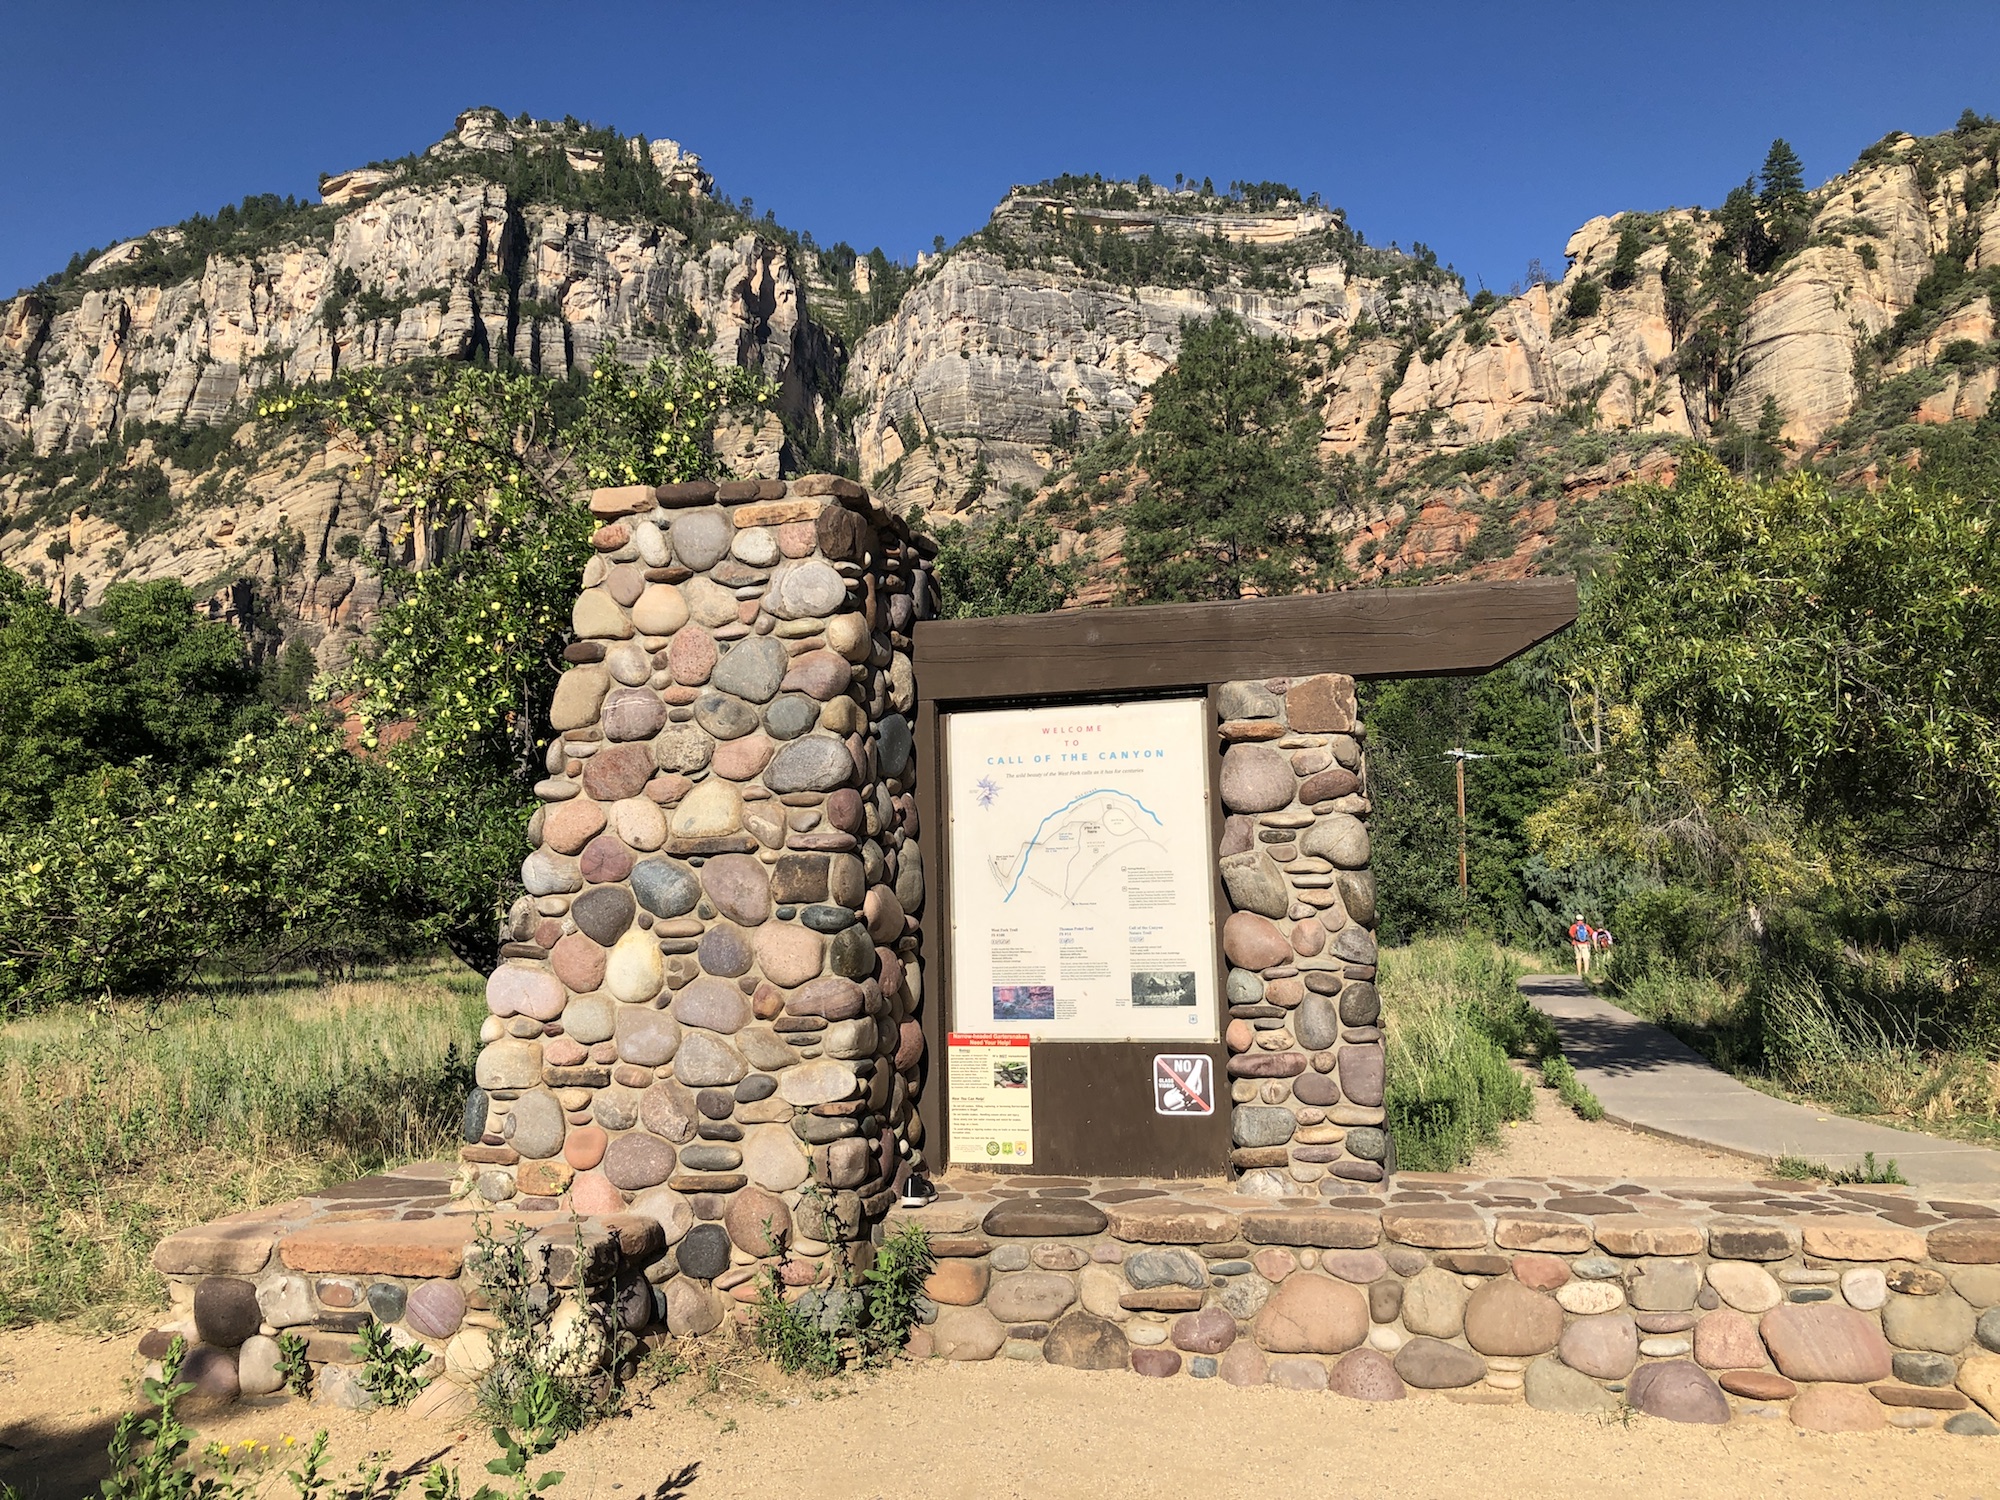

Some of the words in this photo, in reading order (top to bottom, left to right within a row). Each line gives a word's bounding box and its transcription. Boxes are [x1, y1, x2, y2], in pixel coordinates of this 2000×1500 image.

[1042, 725, 1102, 735] WELCOME
[1064, 739, 1079, 747] TO
[987, 756, 1023, 765] CALL
[1034, 754, 1051, 763] OF
[1061, 752, 1088, 762] THE
[1098, 749, 1164, 761] CANYON
[1174, 1059, 1192, 1073] NO
